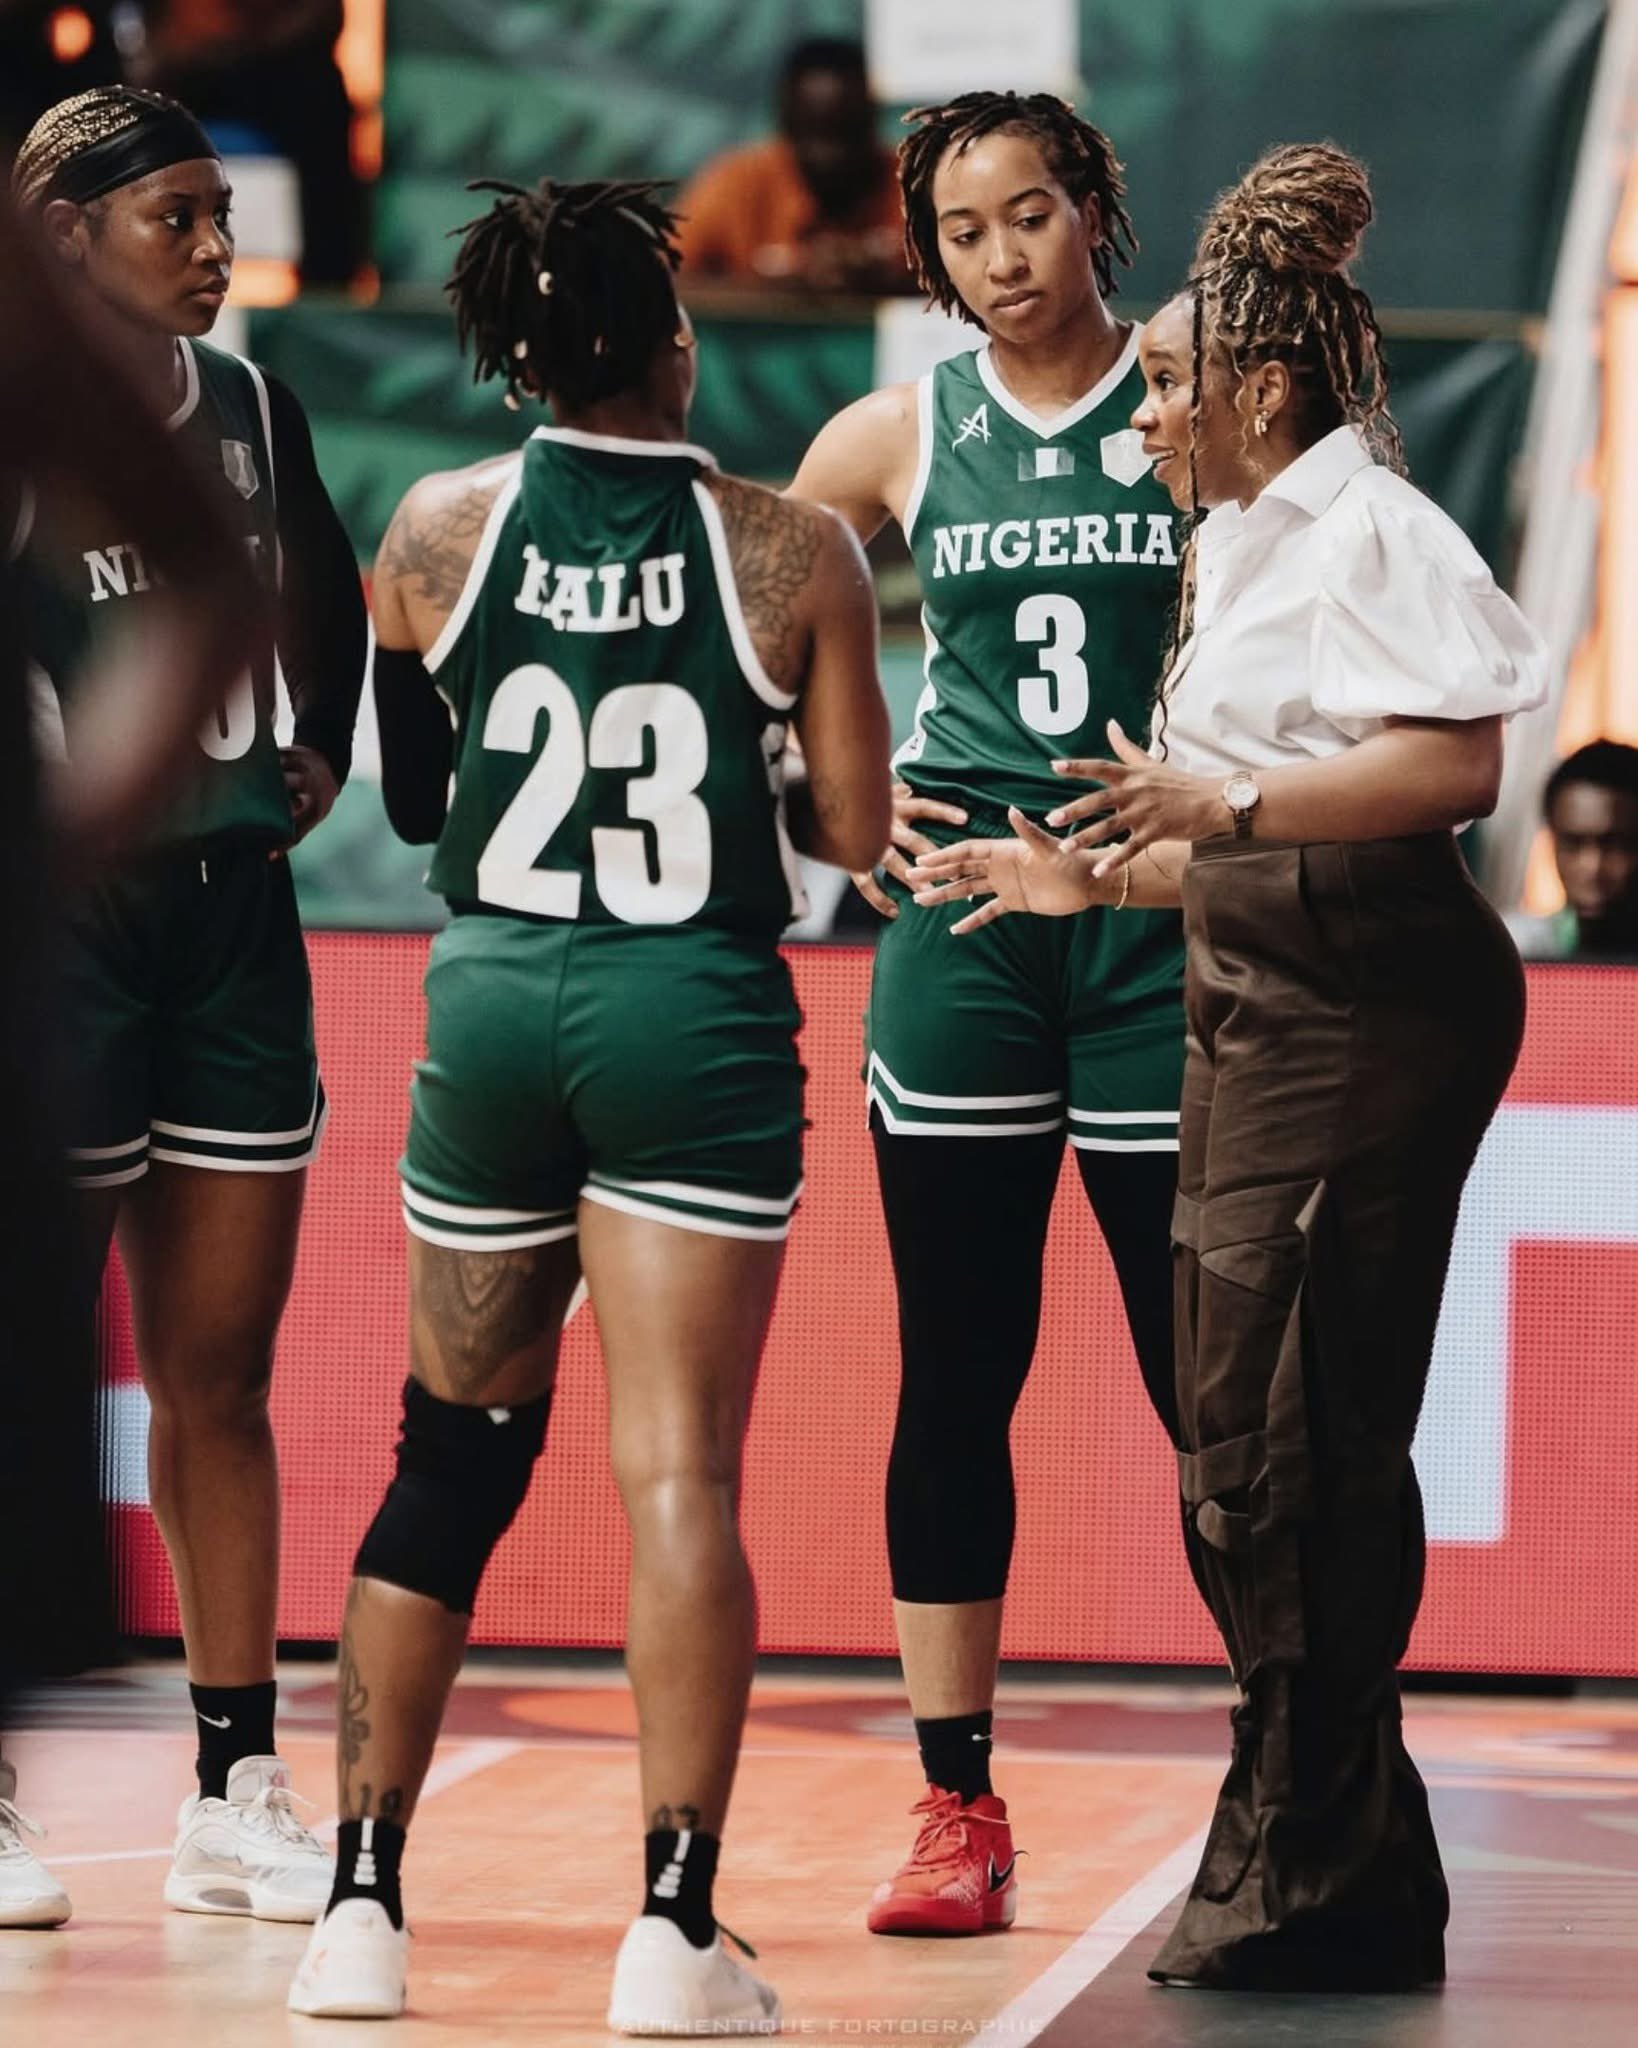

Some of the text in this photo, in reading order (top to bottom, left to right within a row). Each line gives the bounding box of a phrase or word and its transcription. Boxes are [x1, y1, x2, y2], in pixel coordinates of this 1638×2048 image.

[932, 513, 1178, 579] NIGERIA
[1014, 593, 1090, 736] 3
[477, 662, 713, 925] 23
